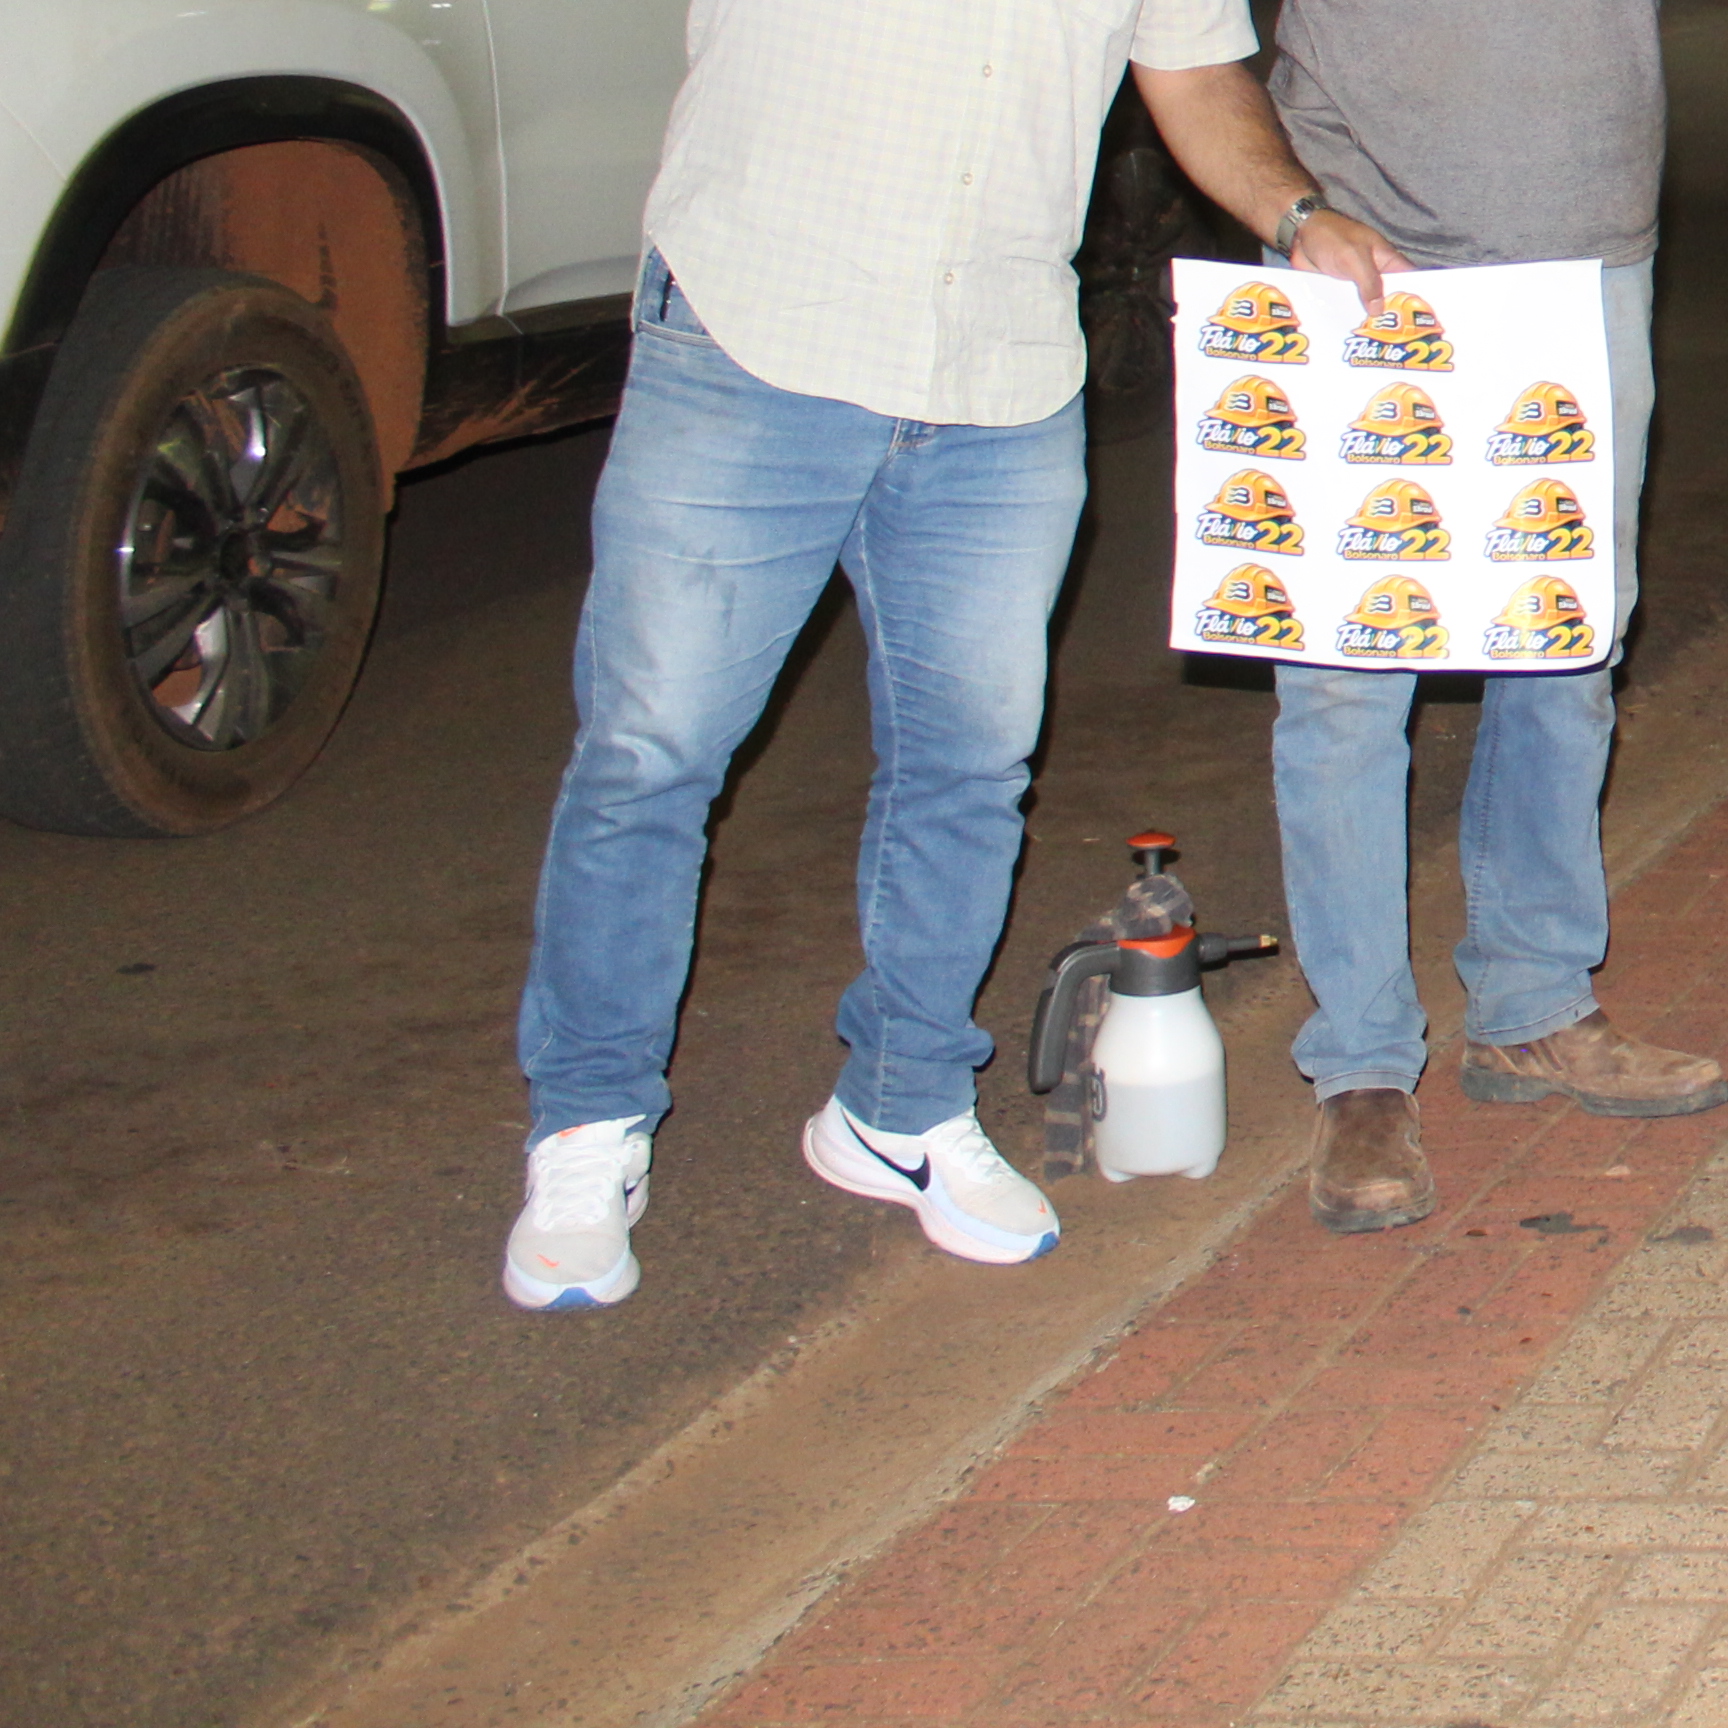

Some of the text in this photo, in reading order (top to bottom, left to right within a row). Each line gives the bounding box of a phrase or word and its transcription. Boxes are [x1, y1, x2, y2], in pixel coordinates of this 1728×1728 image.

[1258, 332, 1308, 363] 22
[1405, 341, 1453, 371] 22
[1256, 426, 1305, 459] 22
[1401, 434, 1452, 464] 22
[1548, 430, 1595, 462] 22
[1255, 521, 1304, 555] 22
[1400, 529, 1450, 559] 22
[1547, 527, 1593, 559] 22
[1256, 616, 1304, 650] 22
[1398, 626, 1449, 658] 22
[1546, 625, 1594, 657] 22
